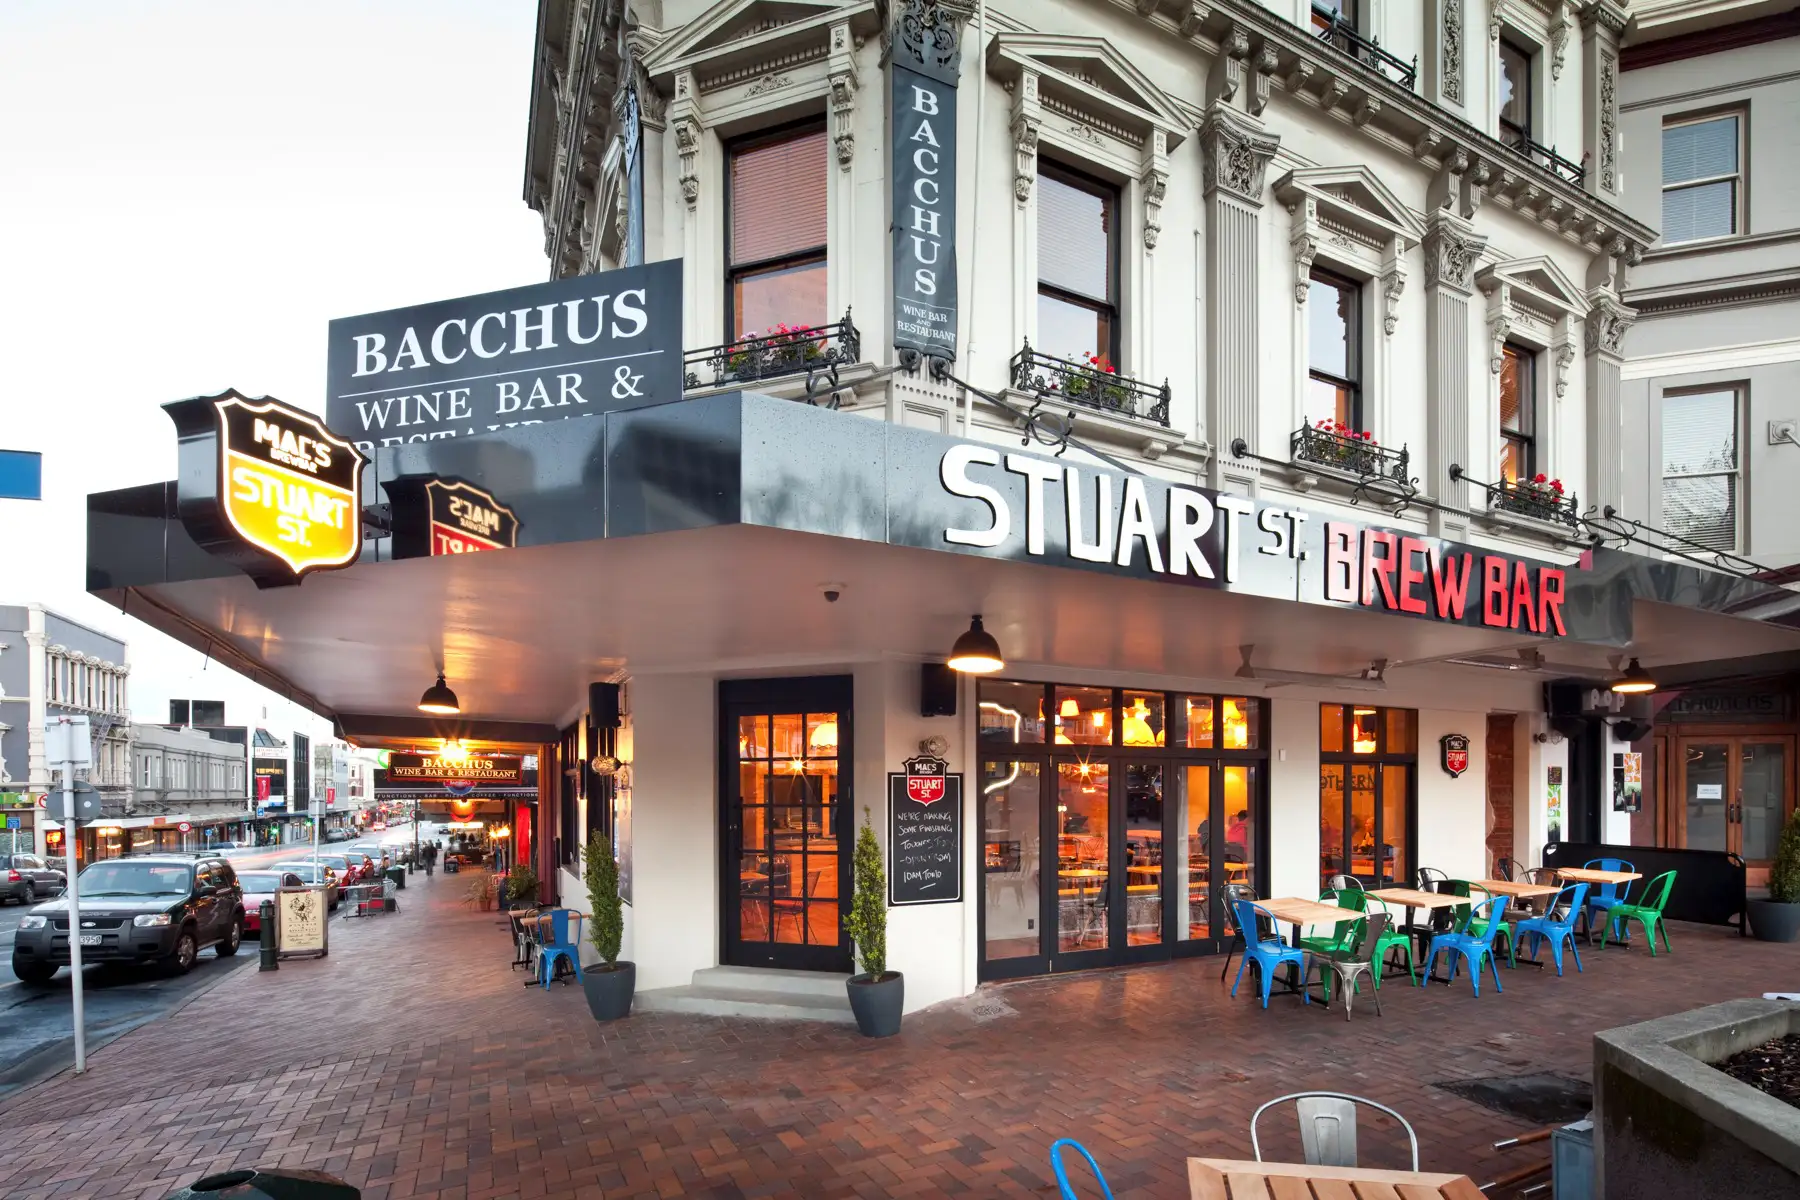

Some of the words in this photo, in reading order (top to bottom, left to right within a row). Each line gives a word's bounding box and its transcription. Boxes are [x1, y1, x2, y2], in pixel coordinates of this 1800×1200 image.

[910, 84, 941, 295] BACCHUS
[903, 304, 927, 318] WINE
[928, 311, 947, 323] BAR
[916, 319, 931, 327] AND
[352, 288, 648, 377] BACCHUS
[897, 320, 956, 342] RESTAURANT
[356, 387, 472, 431] WINE
[496, 372, 588, 414] BAR
[611, 365, 644, 399] &
[254, 418, 332, 468] MAC'S
[233, 467, 349, 529] STUART
[277, 515, 312, 547] ST.
[940, 444, 1254, 583] STUART
[1258, 506, 1310, 561] ST.
[1324, 520, 1472, 620] BREW
[1481, 555, 1567, 636] BAR
[422, 758, 493, 769] BACCHUS
[1448, 752, 1466, 762] STUART
[458, 770, 517, 778] RESTAURANT
[910, 779, 942, 790] STUART
